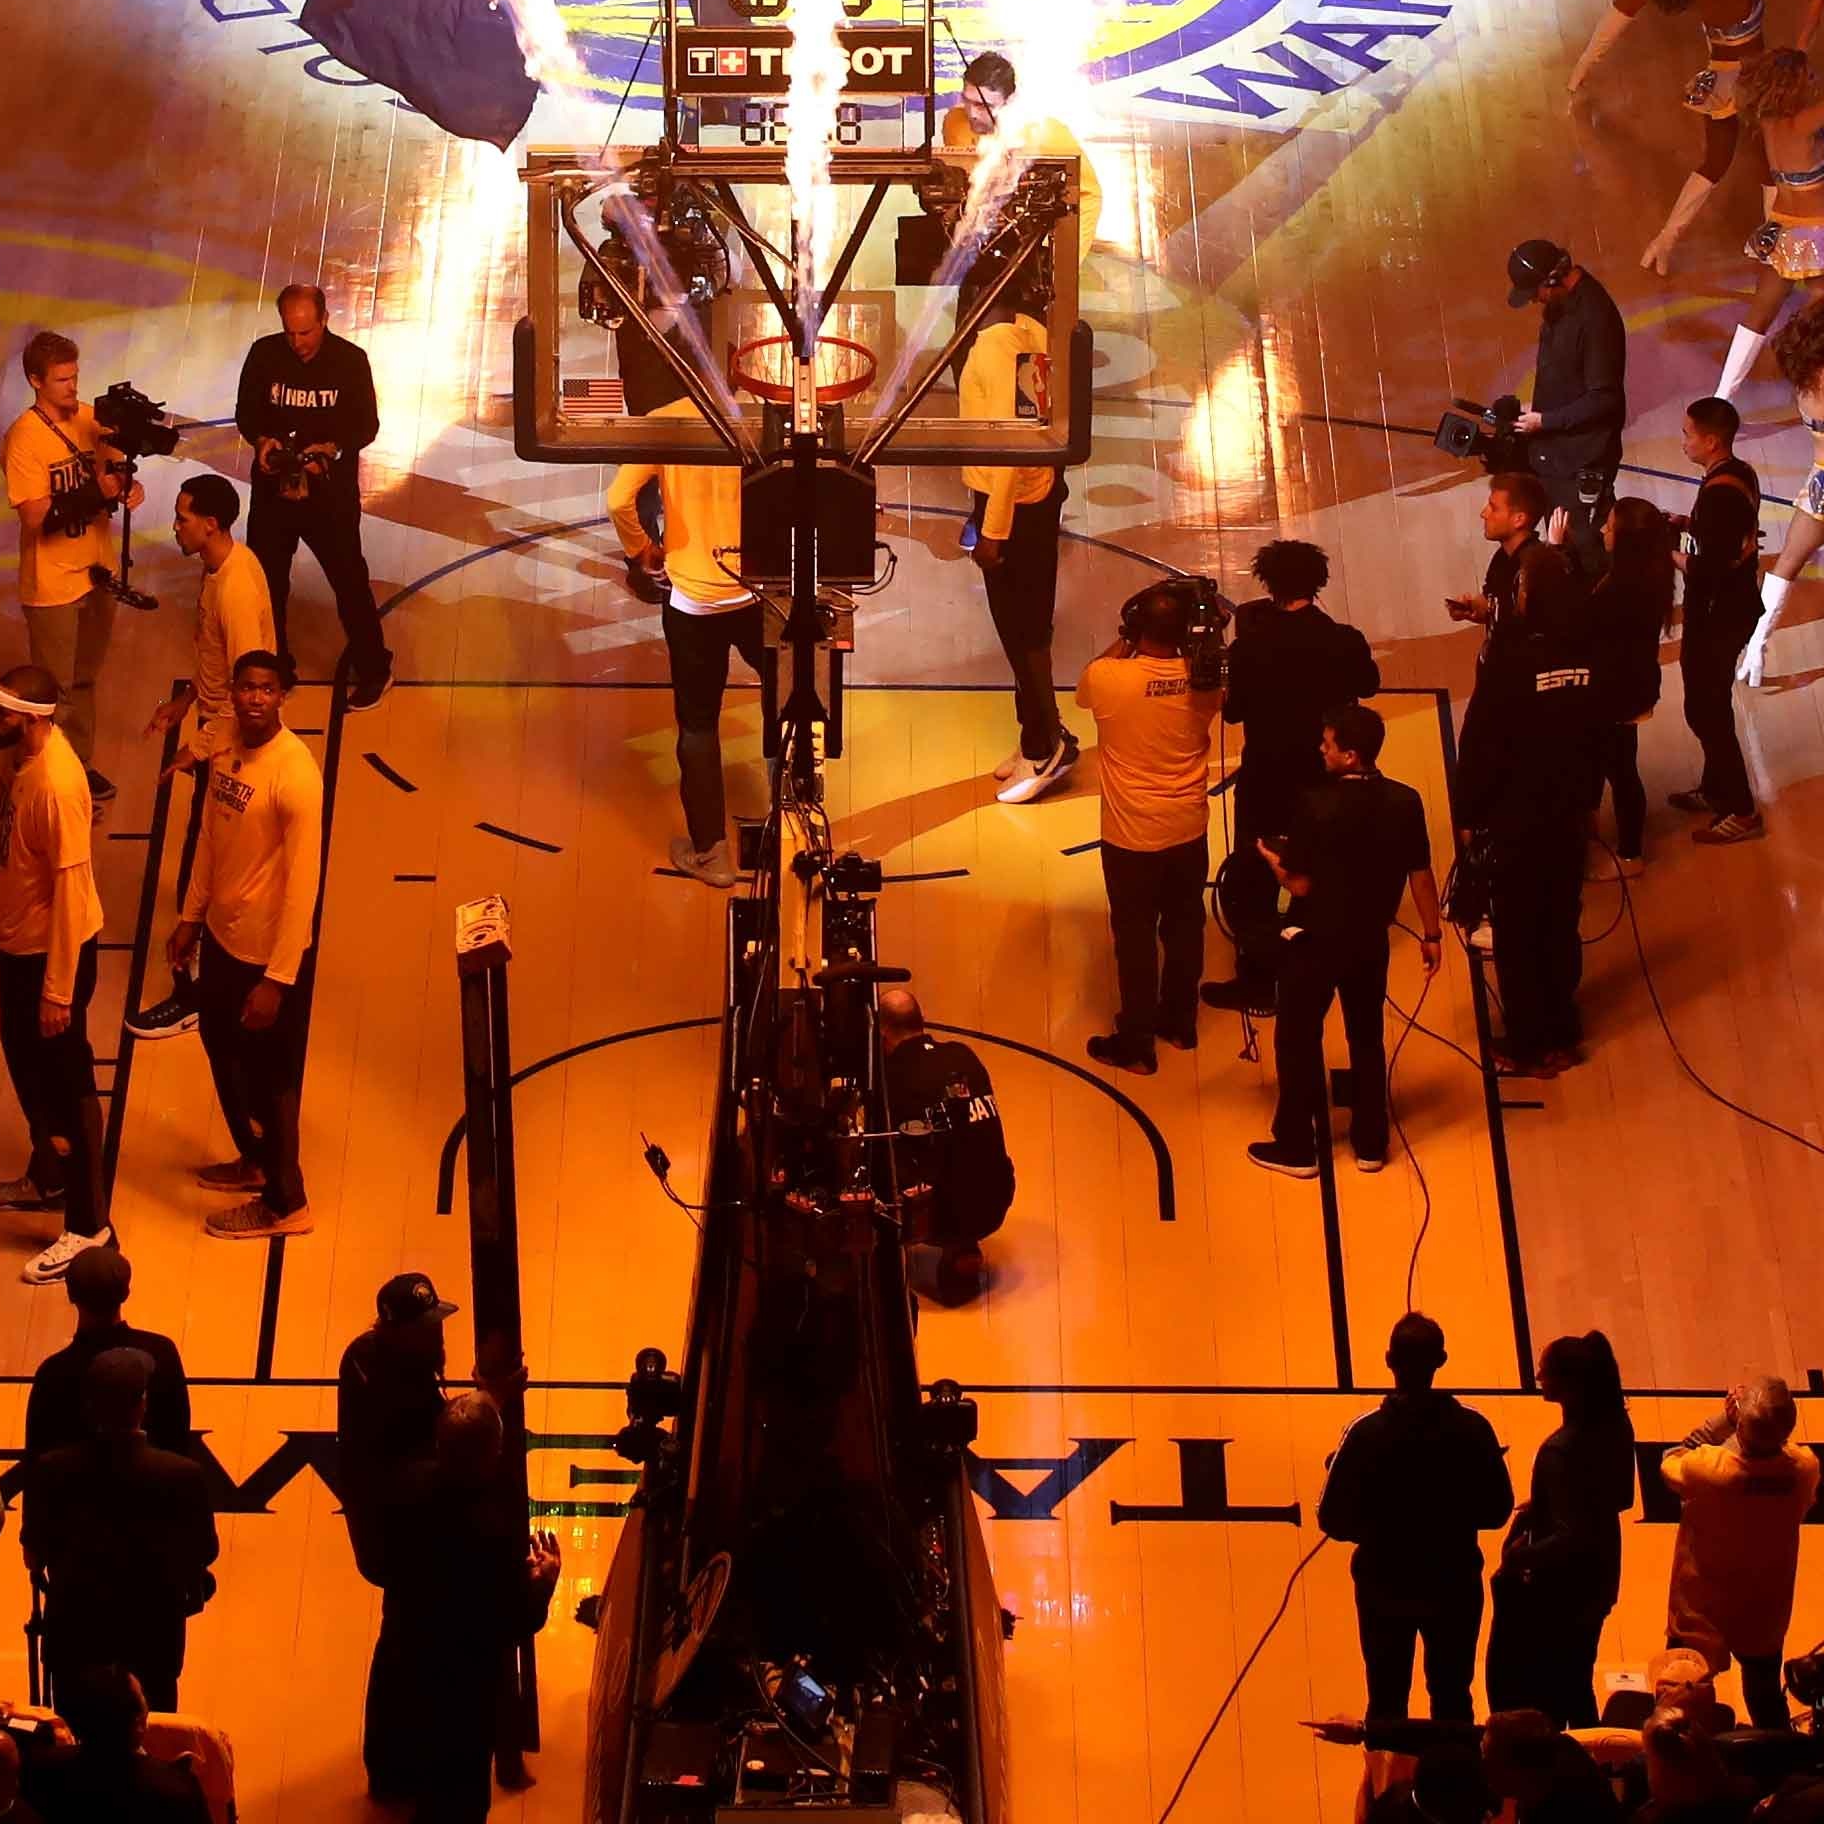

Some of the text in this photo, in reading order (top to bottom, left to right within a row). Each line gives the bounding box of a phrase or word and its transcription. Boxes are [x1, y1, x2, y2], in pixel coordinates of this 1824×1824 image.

[751, 47, 912, 74] TISOT
[285, 388, 338, 407] NBA TV
[1535, 667, 1591, 693] ESPN
